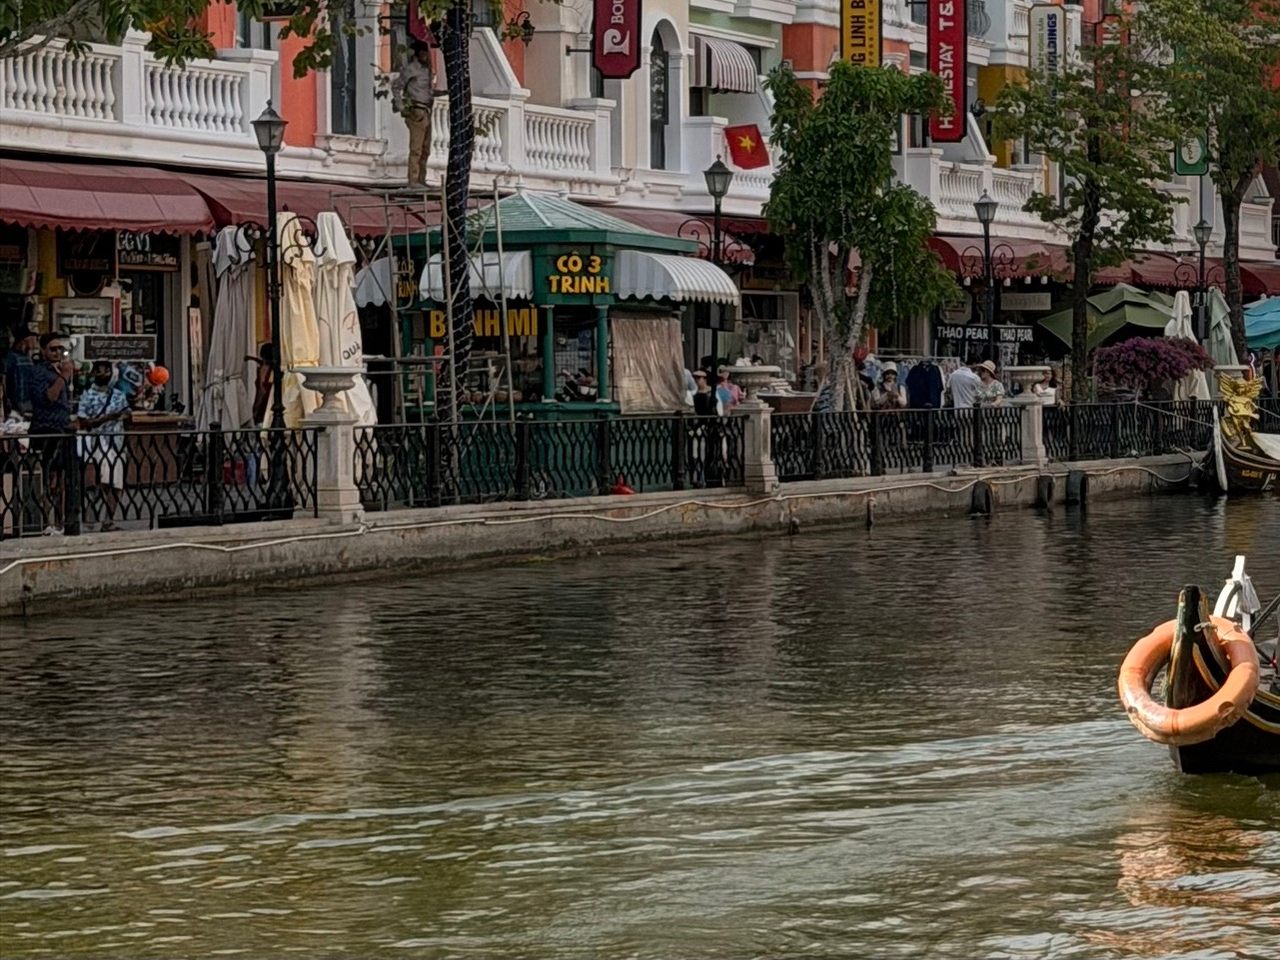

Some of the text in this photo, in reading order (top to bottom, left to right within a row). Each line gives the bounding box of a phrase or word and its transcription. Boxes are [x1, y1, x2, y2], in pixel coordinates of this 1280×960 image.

[850, 15, 866, 48] LINH
[556, 249, 602, 274] CÔ 3
[549, 275, 610, 294] TRINH
[430, 303, 538, 338] BNH MÌ
